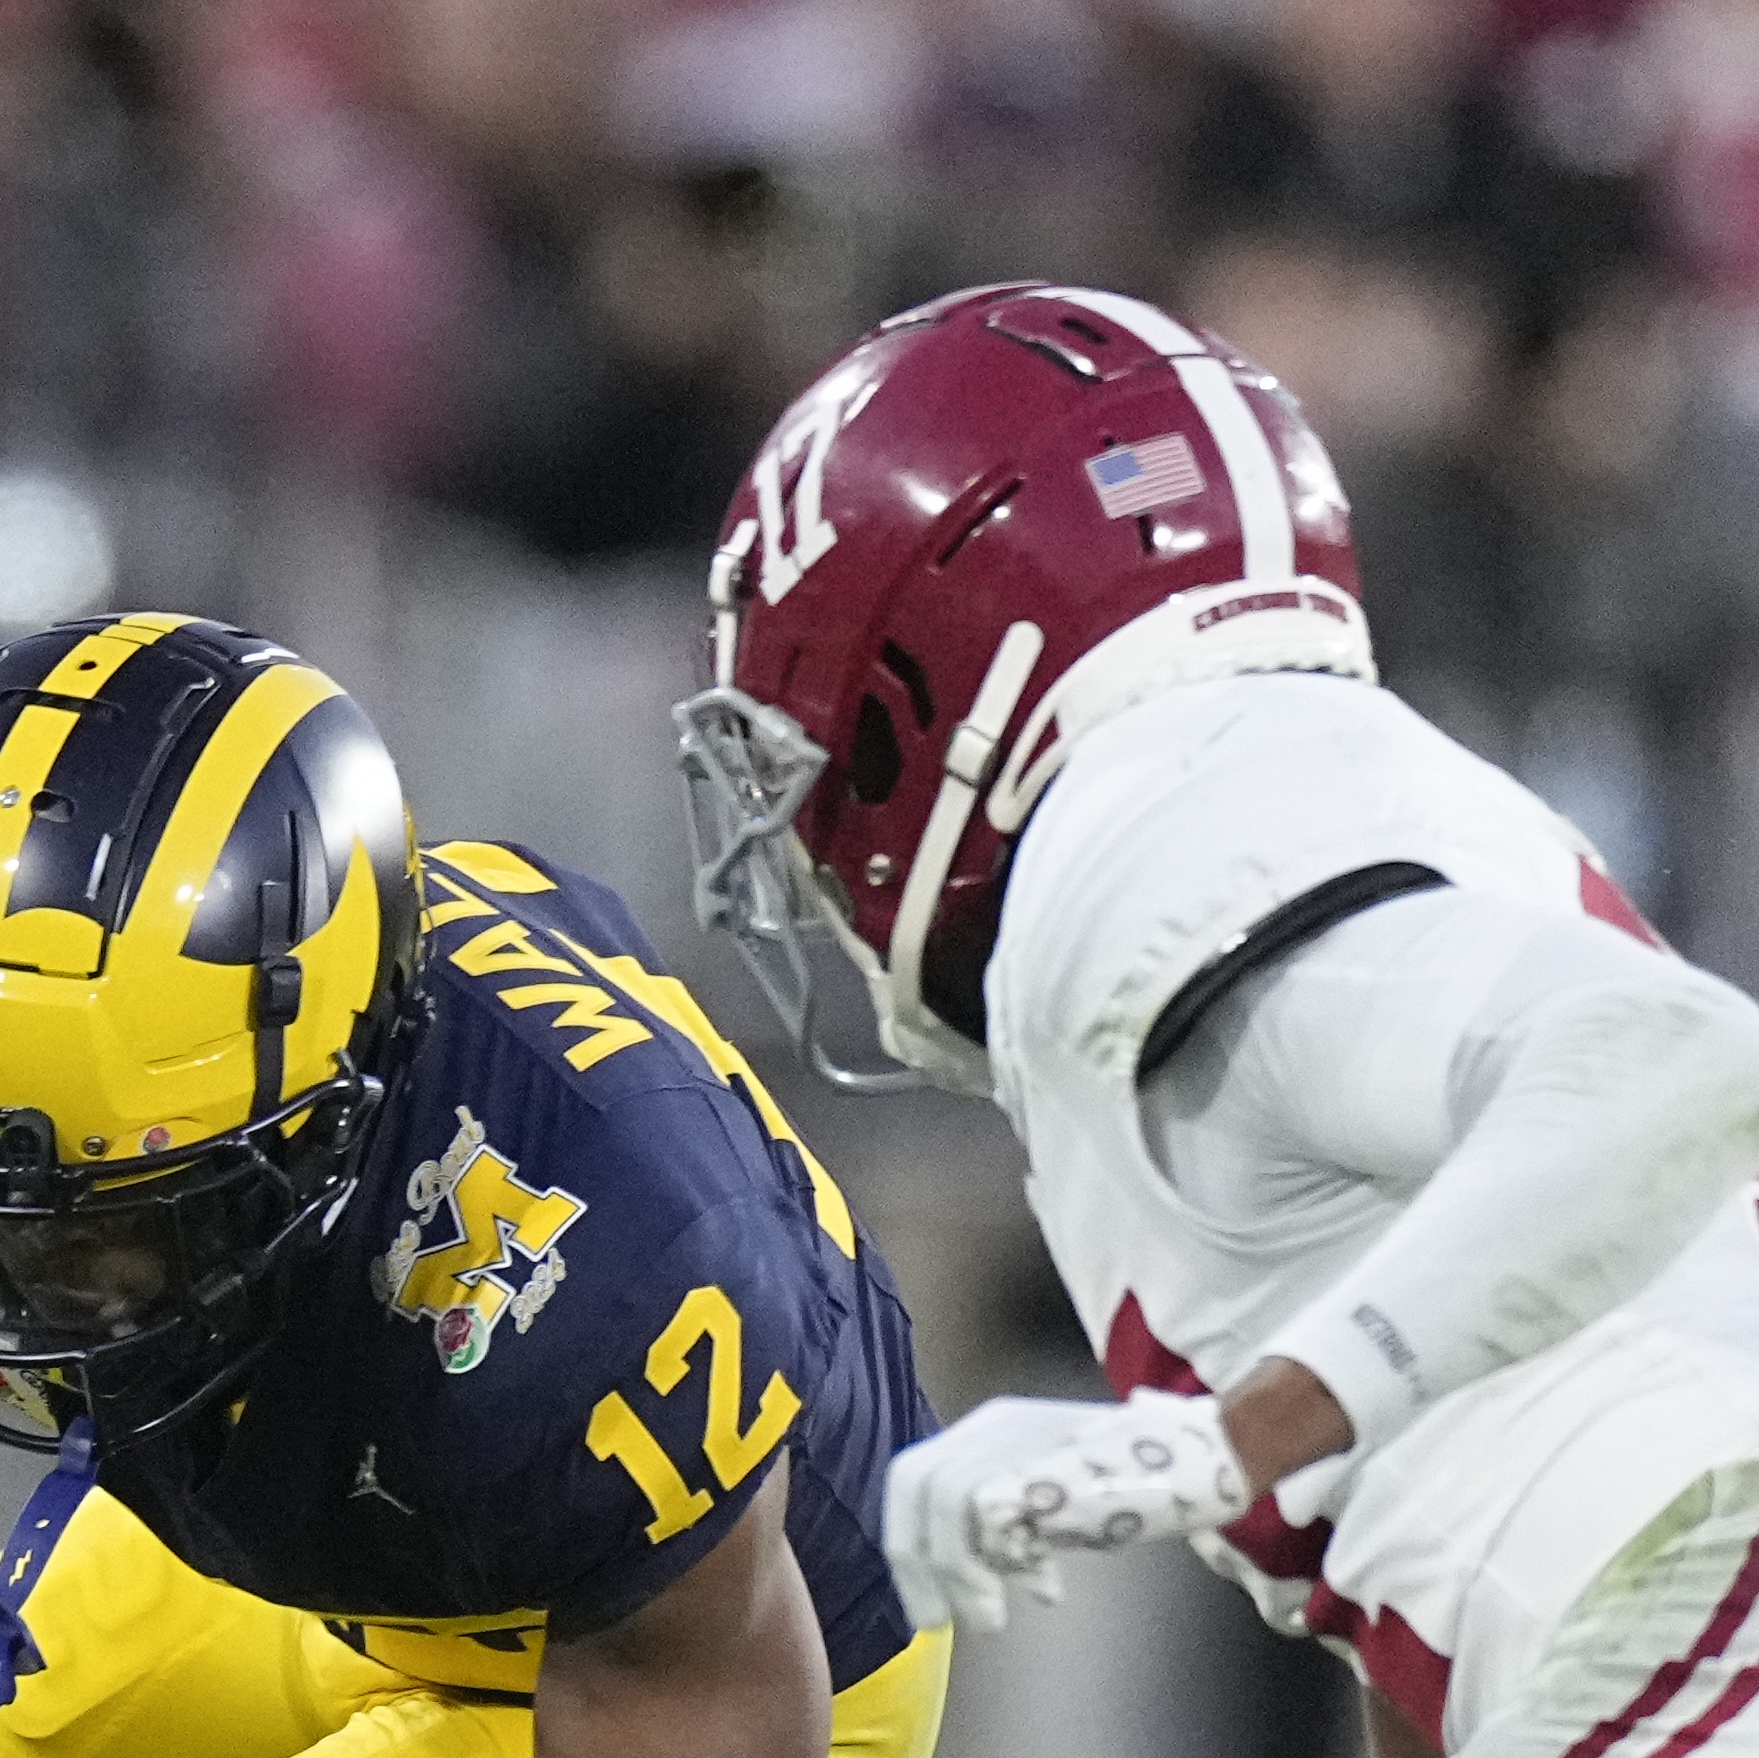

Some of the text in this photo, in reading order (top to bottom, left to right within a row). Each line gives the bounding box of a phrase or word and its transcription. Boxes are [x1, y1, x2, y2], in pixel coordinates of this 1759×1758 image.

[752, 395, 839, 606] 17
[420, 872, 654, 1072] WAL
[393, 1144, 589, 1330] M
[585, 1285, 802, 1545] 12
